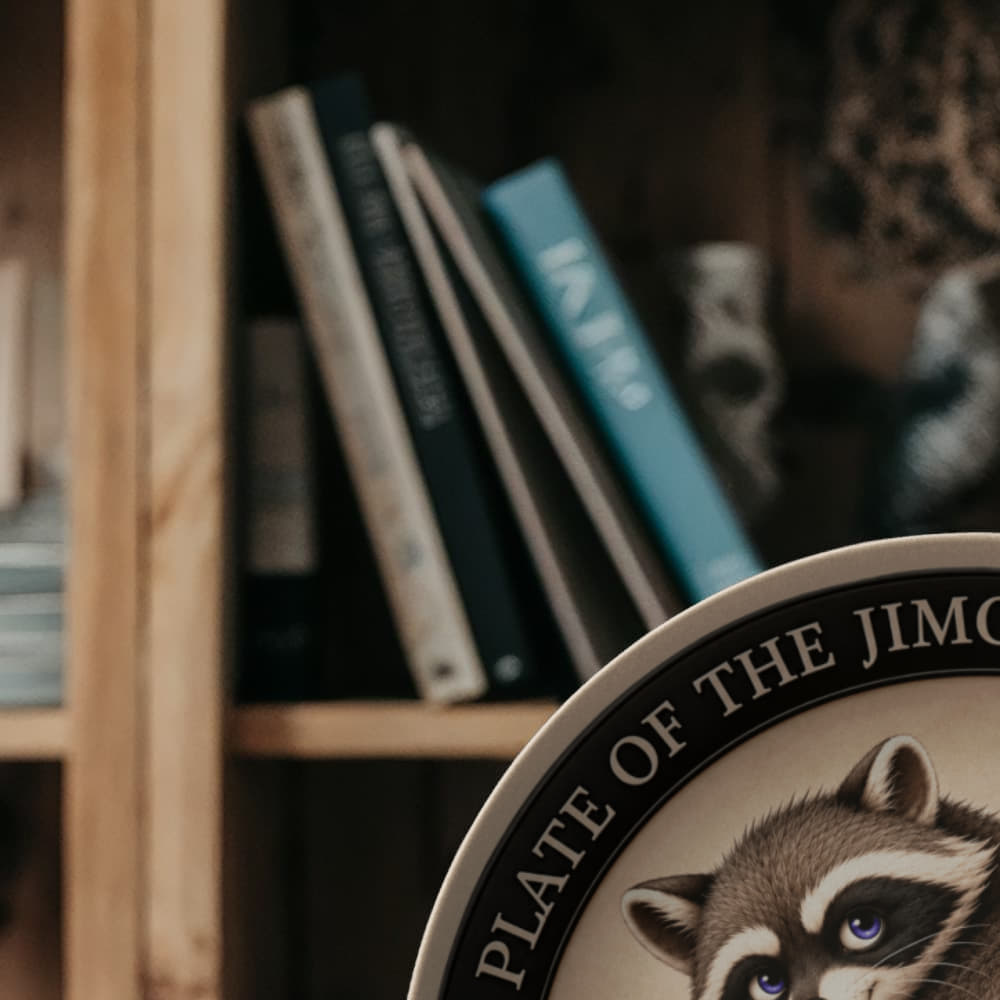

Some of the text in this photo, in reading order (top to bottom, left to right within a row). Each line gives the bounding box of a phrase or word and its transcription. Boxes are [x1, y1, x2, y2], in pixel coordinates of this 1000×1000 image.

[475, 786, 615, 990] PLATE
[610, 701, 688, 787] OF
[693, 622, 836, 716] THE
